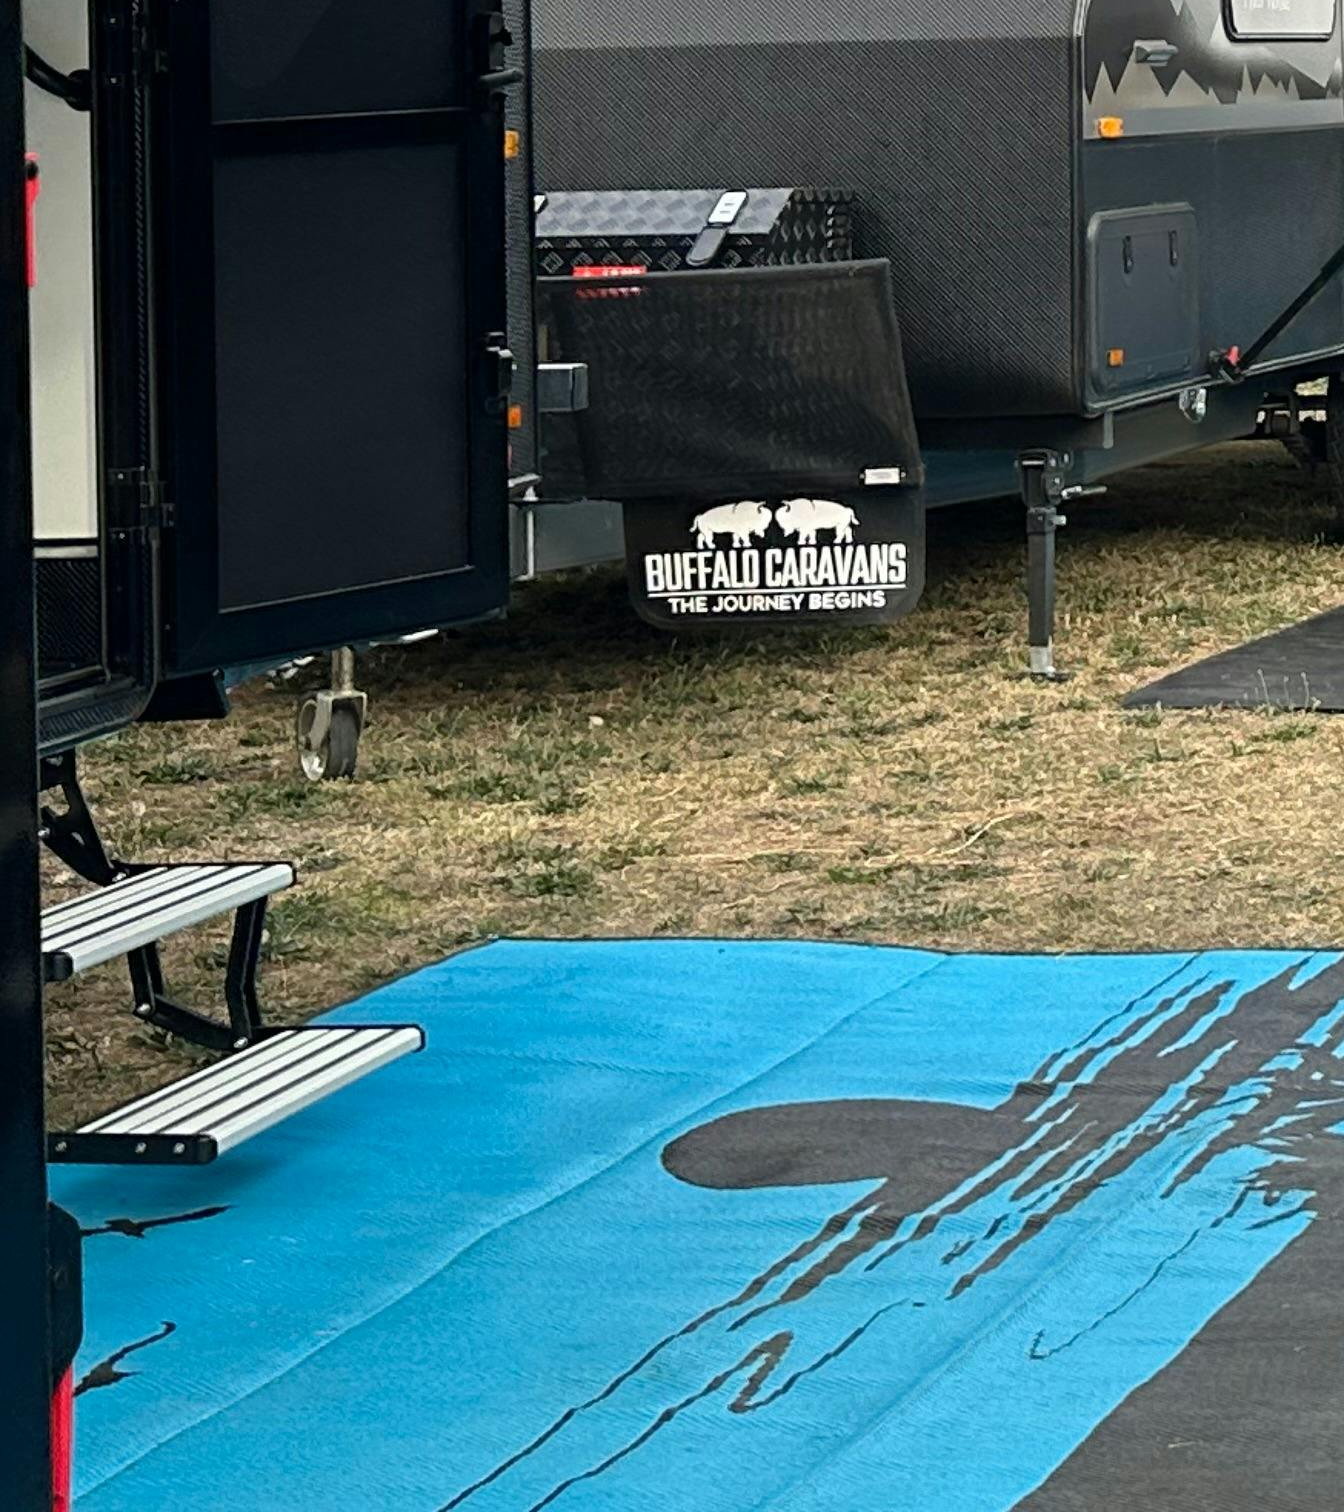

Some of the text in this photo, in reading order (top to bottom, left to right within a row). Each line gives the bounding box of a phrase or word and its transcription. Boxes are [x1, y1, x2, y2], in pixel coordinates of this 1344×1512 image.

[645, 543, 907, 591] BUFFALO CARAVANS
[667, 590, 886, 614] THE JOURNEY BEGINS
